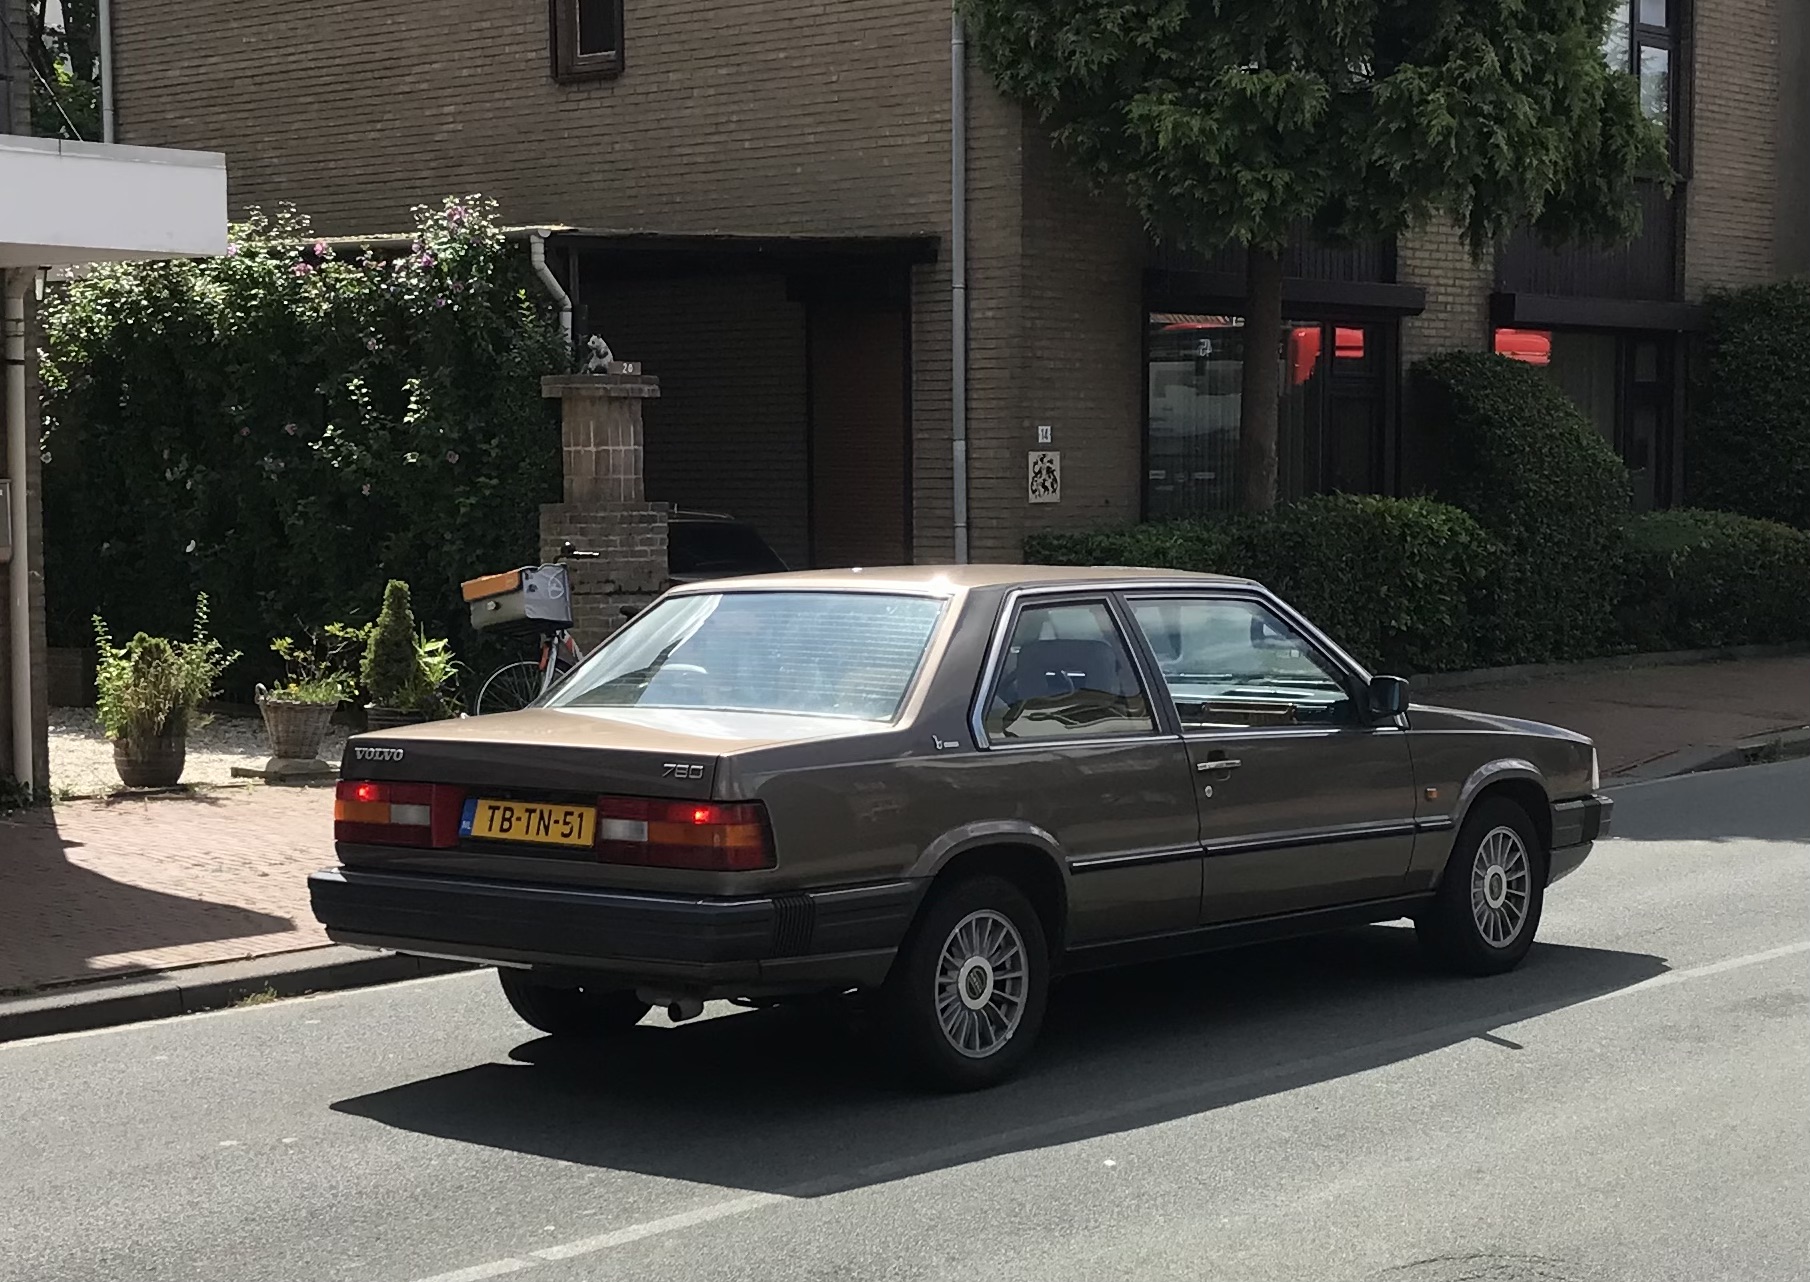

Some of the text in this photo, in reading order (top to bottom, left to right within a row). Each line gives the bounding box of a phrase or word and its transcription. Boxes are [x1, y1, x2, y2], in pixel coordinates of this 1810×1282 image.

[354, 747, 404, 761] VOLVO
[661, 763, 704, 779] 780
[488, 805, 584, 840] TB-TN-51
